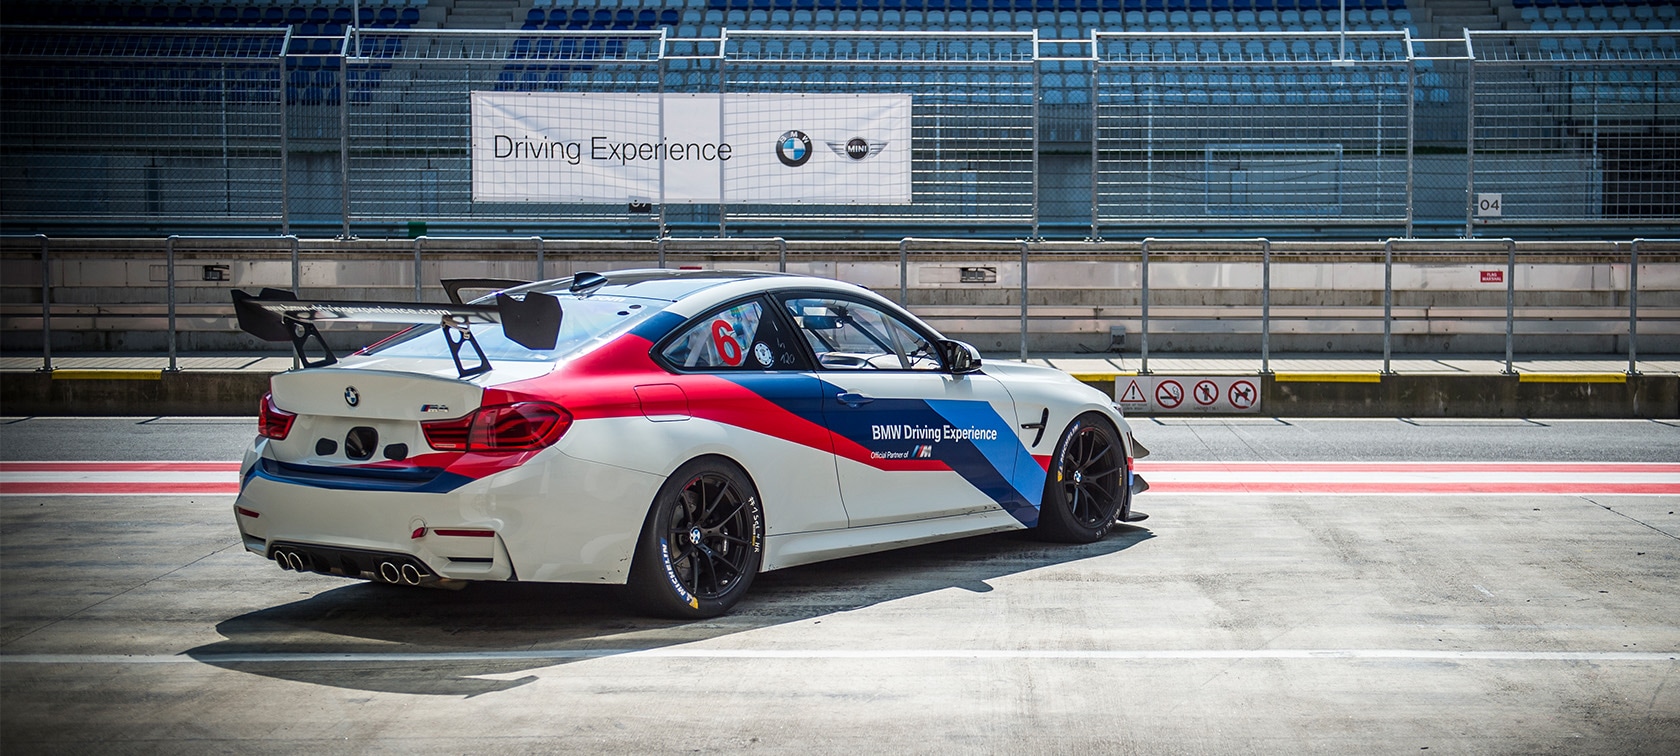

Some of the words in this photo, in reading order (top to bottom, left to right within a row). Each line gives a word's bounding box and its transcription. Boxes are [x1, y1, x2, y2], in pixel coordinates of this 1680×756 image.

[494, 135, 581, 165] Driving
[591, 136, 732, 166] Experience
[847, 145, 867, 153] MINI
[1480, 199, 1500, 211] 04
[711, 318, 742, 367] 6
[871, 425, 901, 440] BMW
[904, 425, 941, 442] Driving
[943, 425, 997, 442] Experience
[887, 451, 903, 459] Partner
[662, 543, 686, 596] MICHELIN
